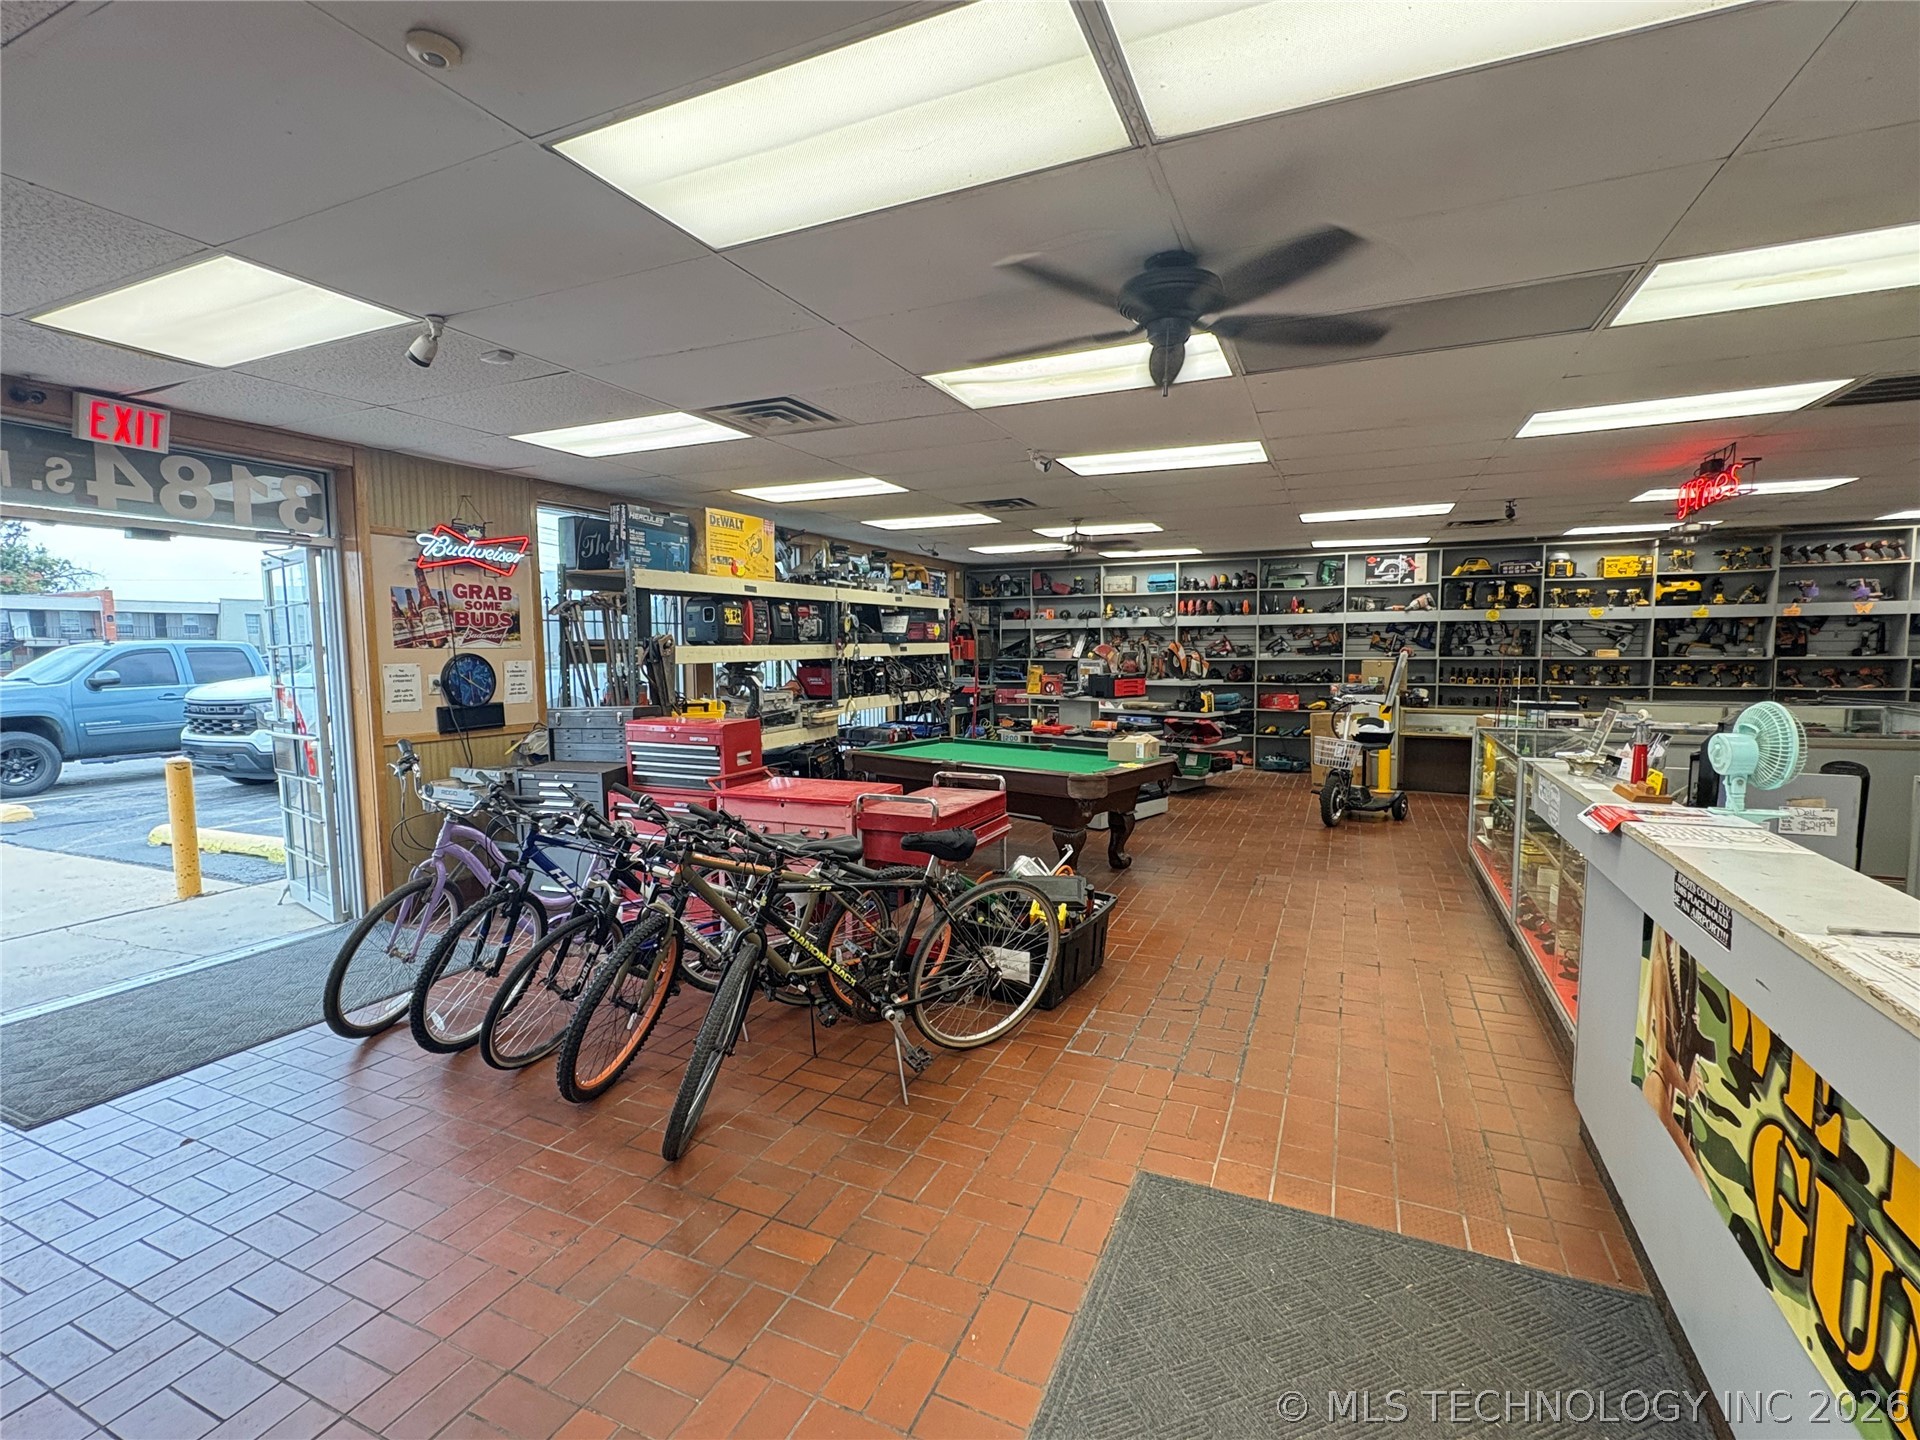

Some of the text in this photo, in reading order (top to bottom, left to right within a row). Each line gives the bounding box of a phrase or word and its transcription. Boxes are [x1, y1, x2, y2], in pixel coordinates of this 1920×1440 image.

[90, 400, 165, 449] EXIT
[629, 511, 664, 525] HERCULES
[416, 533, 525, 563] Budweiser
[452, 583, 513, 601] GRAB
[464, 601, 503, 611] SOME
[455, 612, 513, 628] BUDS
[465, 630, 508, 639] Budweiser
[1677, 873, 1697, 895] IDIOTS
[1696, 886, 1717, 907] COULD
[1674, 883, 1729, 929] THIS PLACE WOULD
[1680, 900, 1691, 913] AN
[1690, 907, 1729, 942] AIRPORT!!!
[788, 927, 857, 987] DIAMOND BACK
